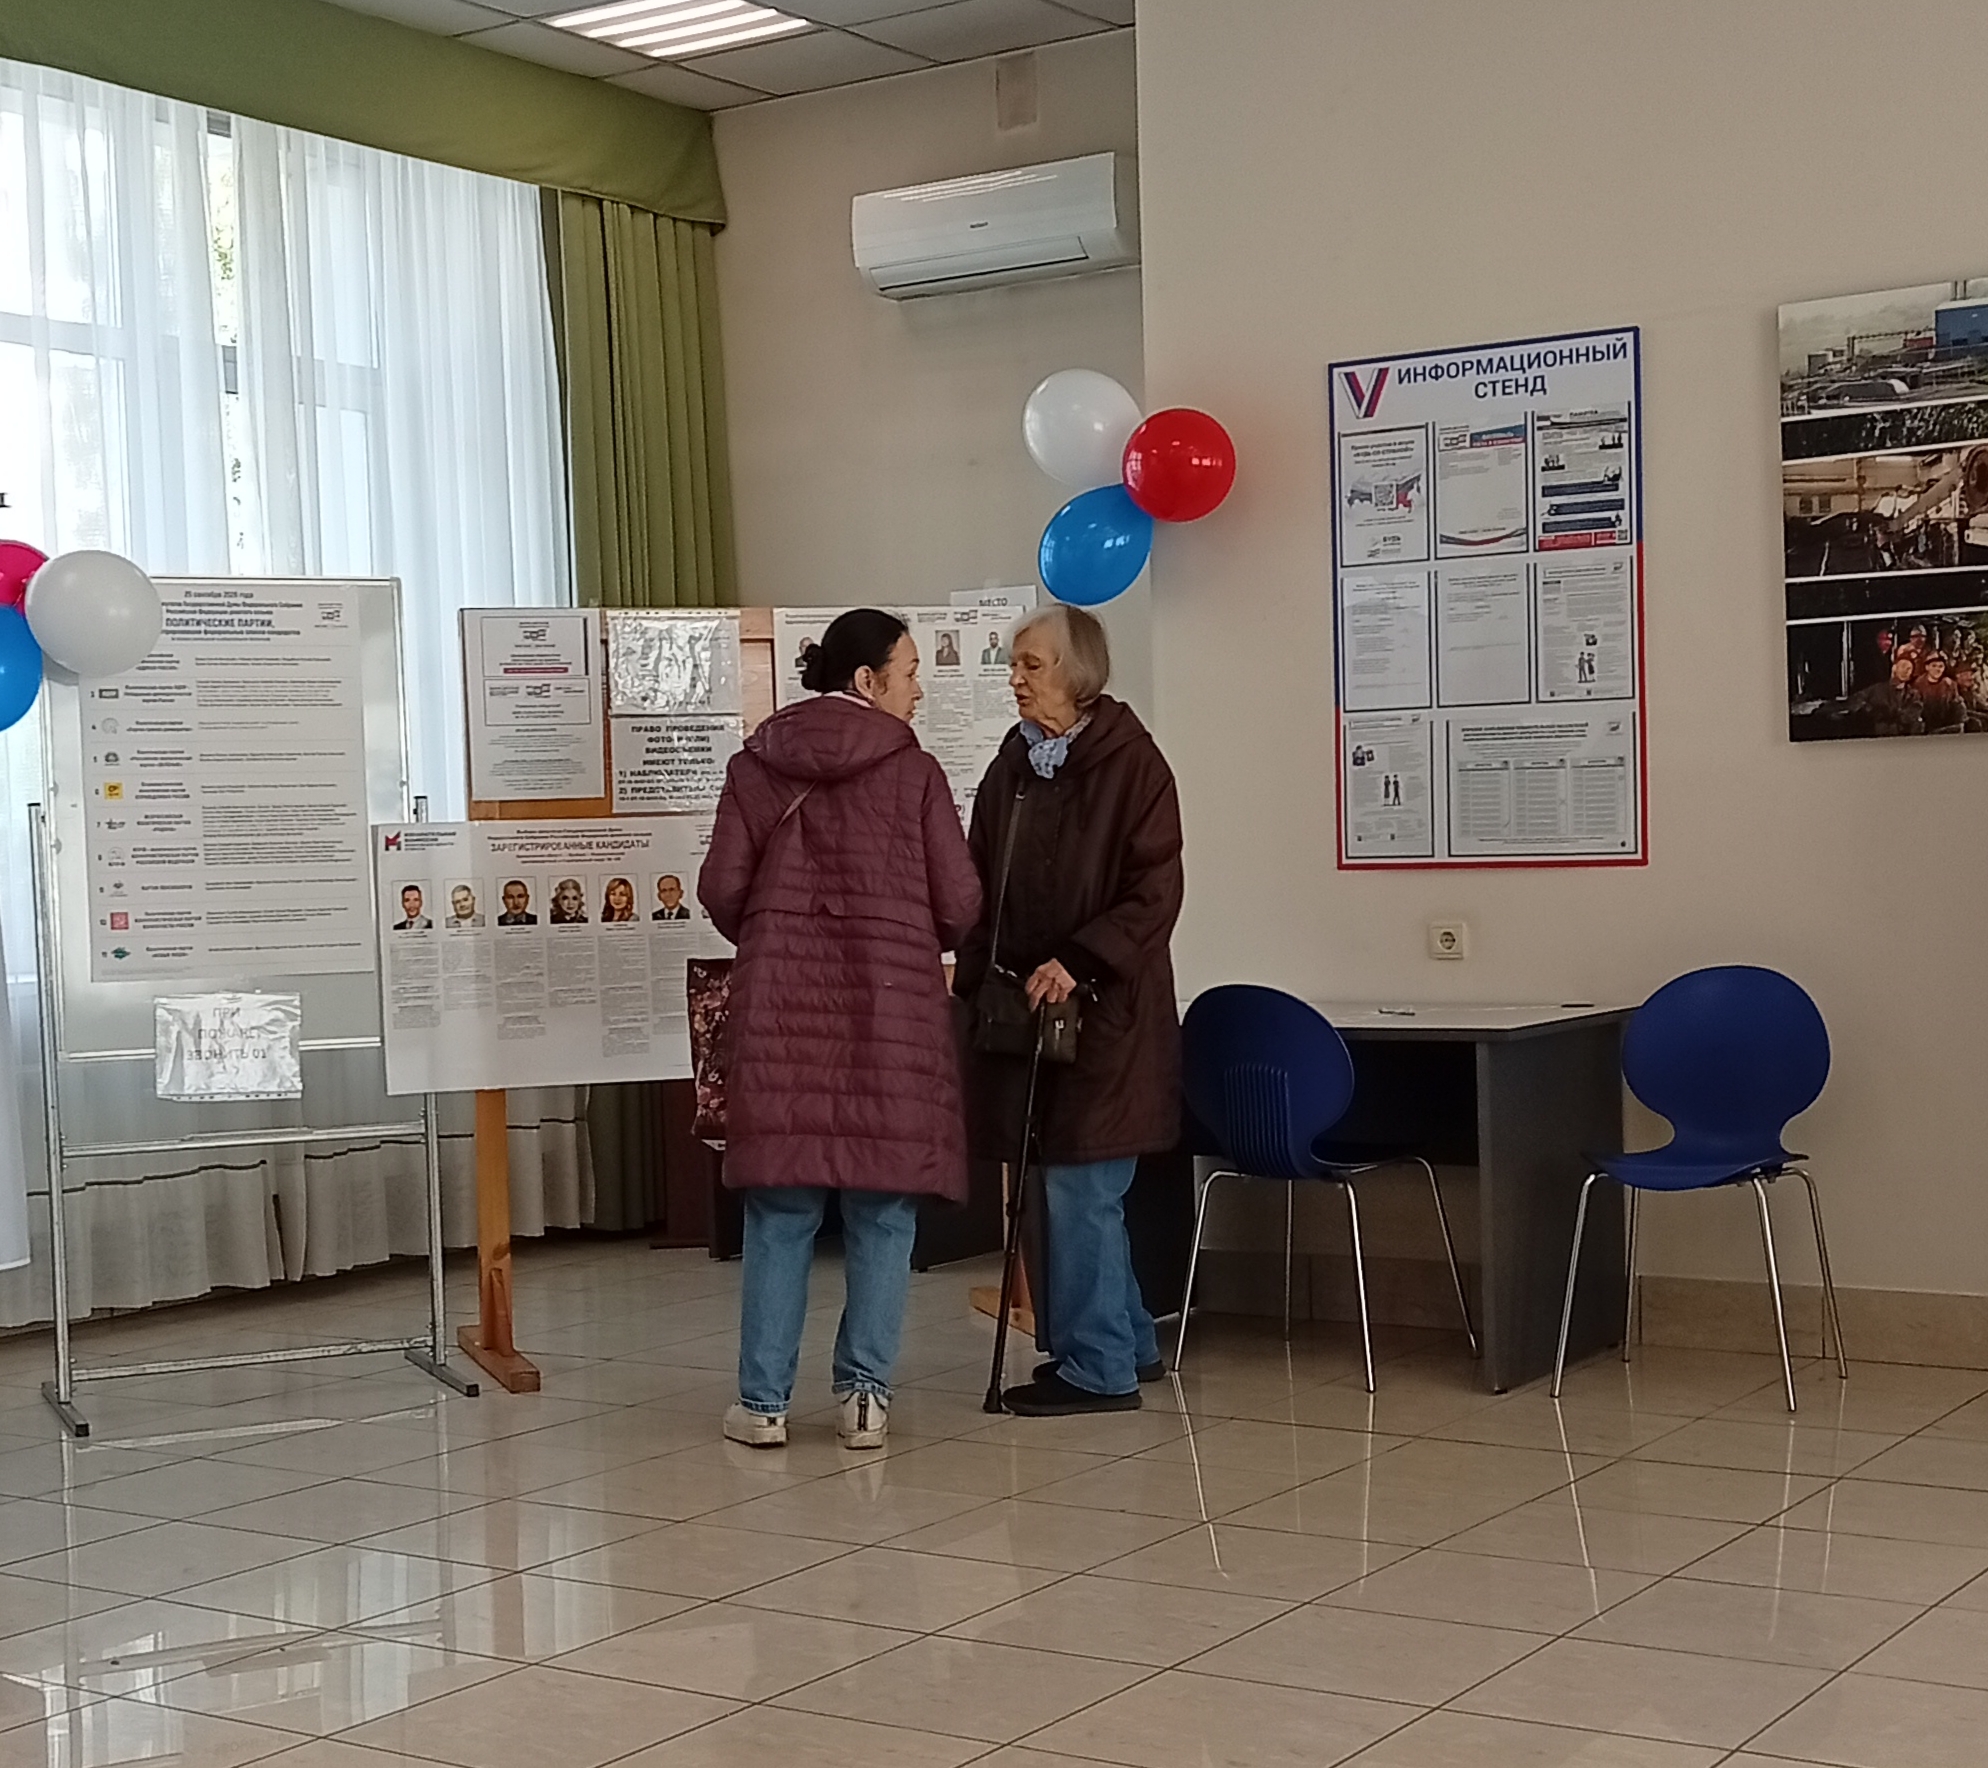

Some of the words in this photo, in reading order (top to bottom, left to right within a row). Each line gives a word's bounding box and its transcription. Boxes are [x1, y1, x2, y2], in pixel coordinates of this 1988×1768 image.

[1397, 337, 1628, 384] ИНФОРМАЦИОННЫЙ
[1474, 374, 1548, 399] СТЕНД
[631, 725, 662, 733] ПРАВО
[643, 758, 675, 766] ИМЕЮТ
